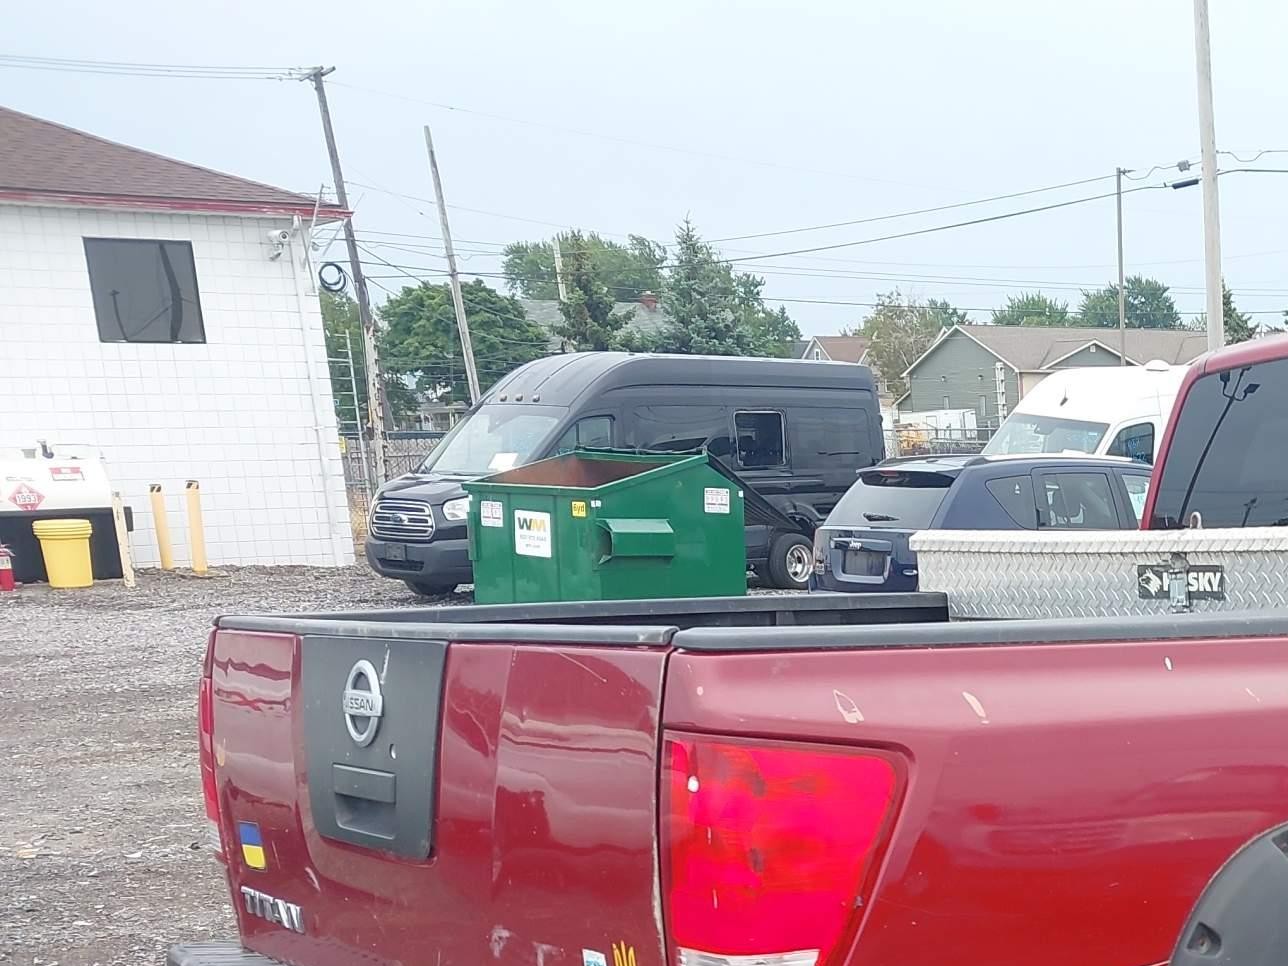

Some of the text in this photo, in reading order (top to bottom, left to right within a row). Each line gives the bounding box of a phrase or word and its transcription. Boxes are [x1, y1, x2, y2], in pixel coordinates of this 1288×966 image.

[17, 494, 36, 503] 1993
[517, 517, 546, 532] WM
[848, 540, 862, 550] Jeep
[1162, 571, 1222, 592] HSKY
